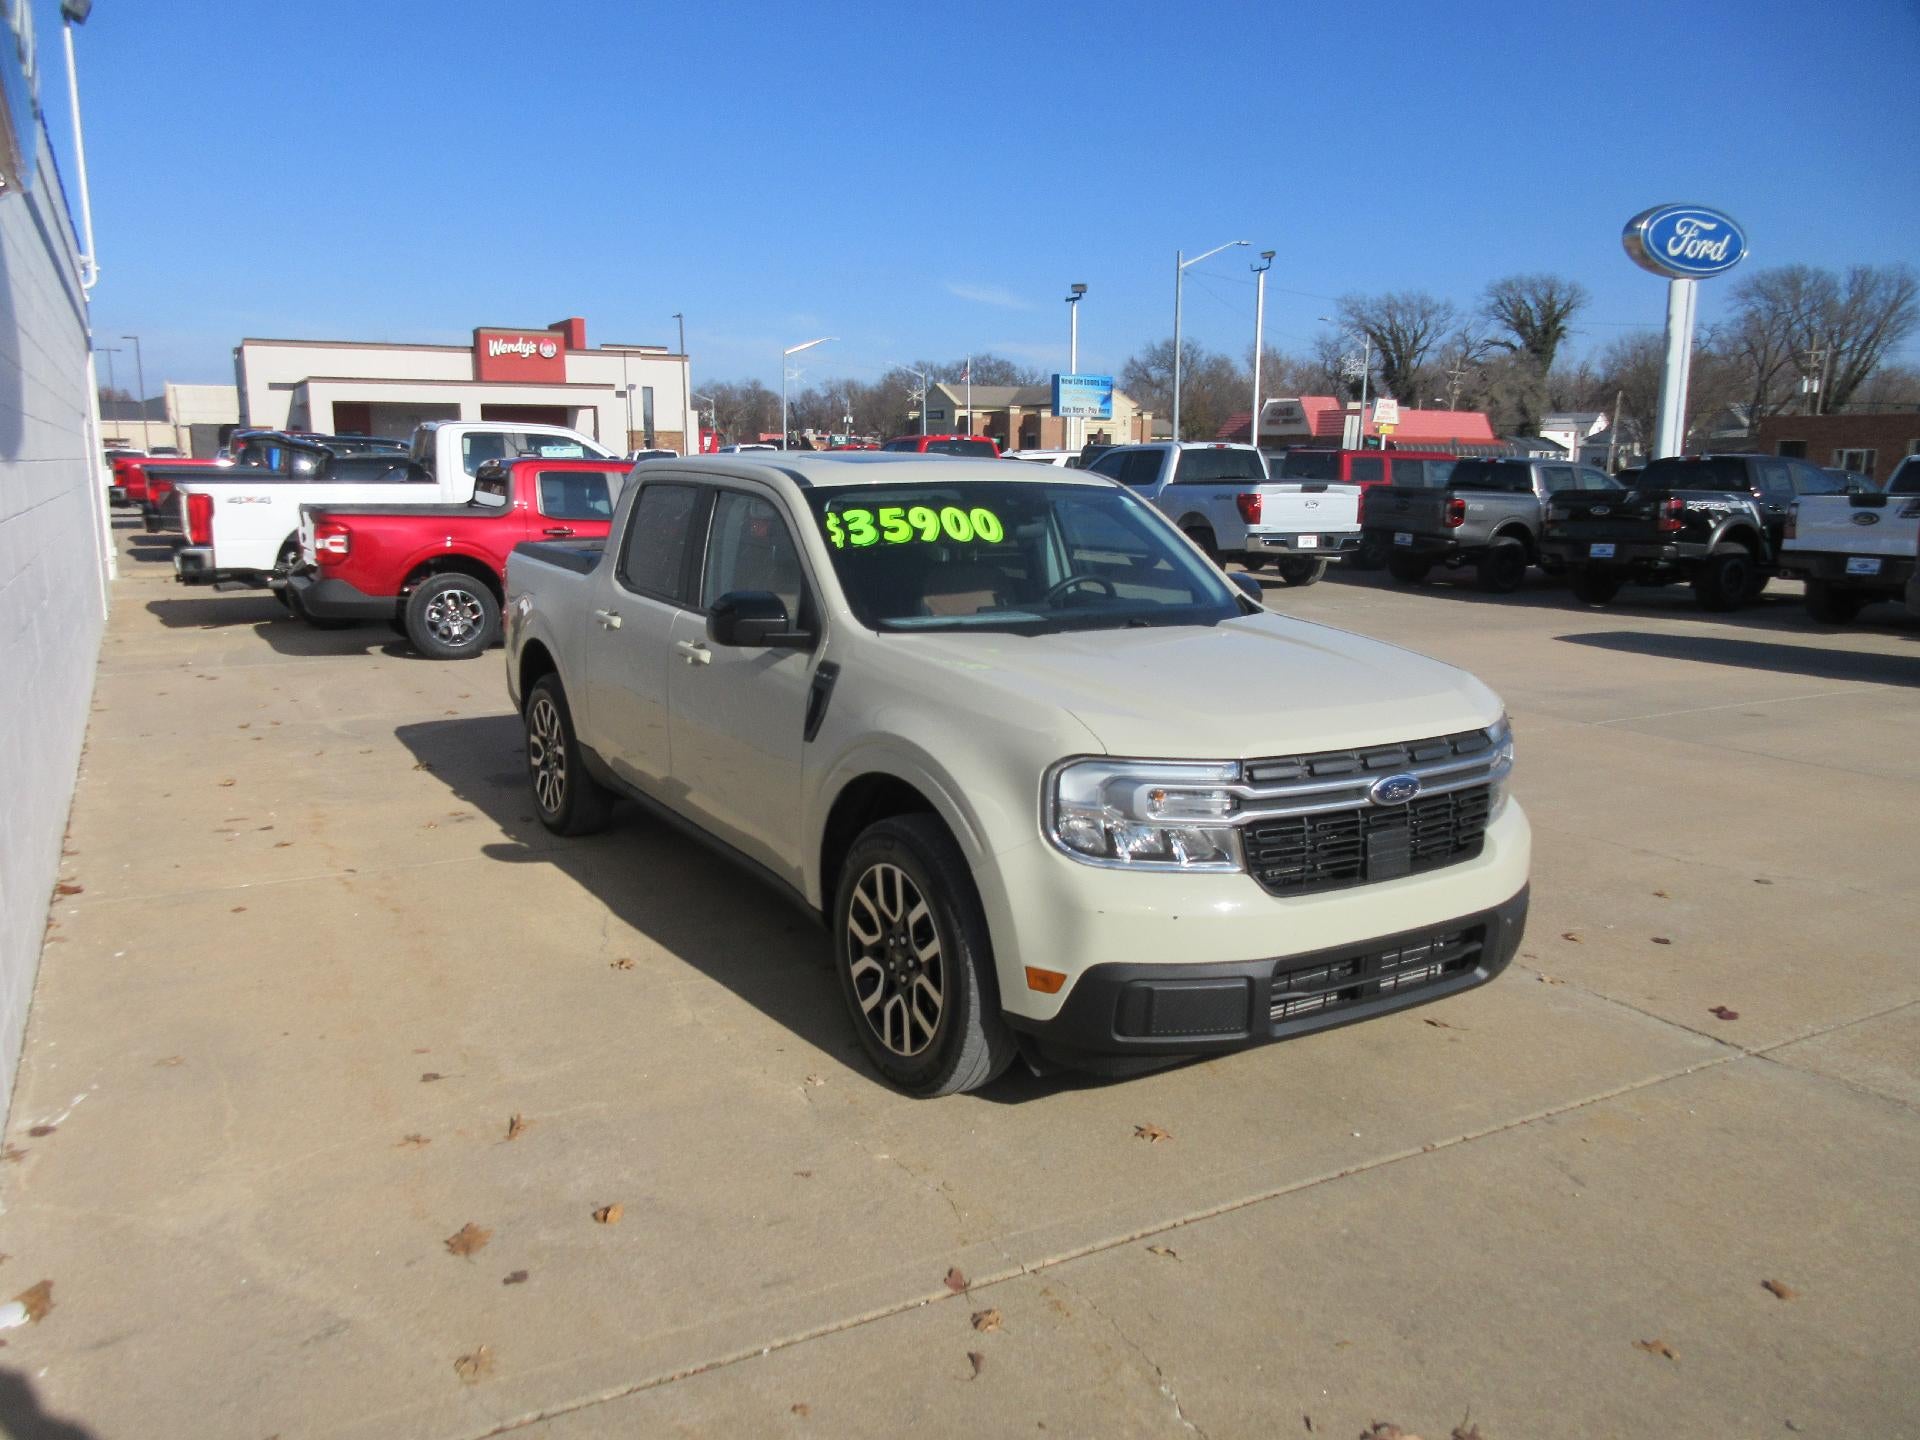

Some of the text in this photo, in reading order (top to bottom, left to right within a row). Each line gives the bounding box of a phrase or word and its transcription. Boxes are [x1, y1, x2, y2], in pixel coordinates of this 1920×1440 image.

[1666, 218, 1732, 262] Ford
[488, 337, 537, 358] Wendy's
[1088, 407, 1098, 415] Pay
[825, 506, 1004, 549] $35900
